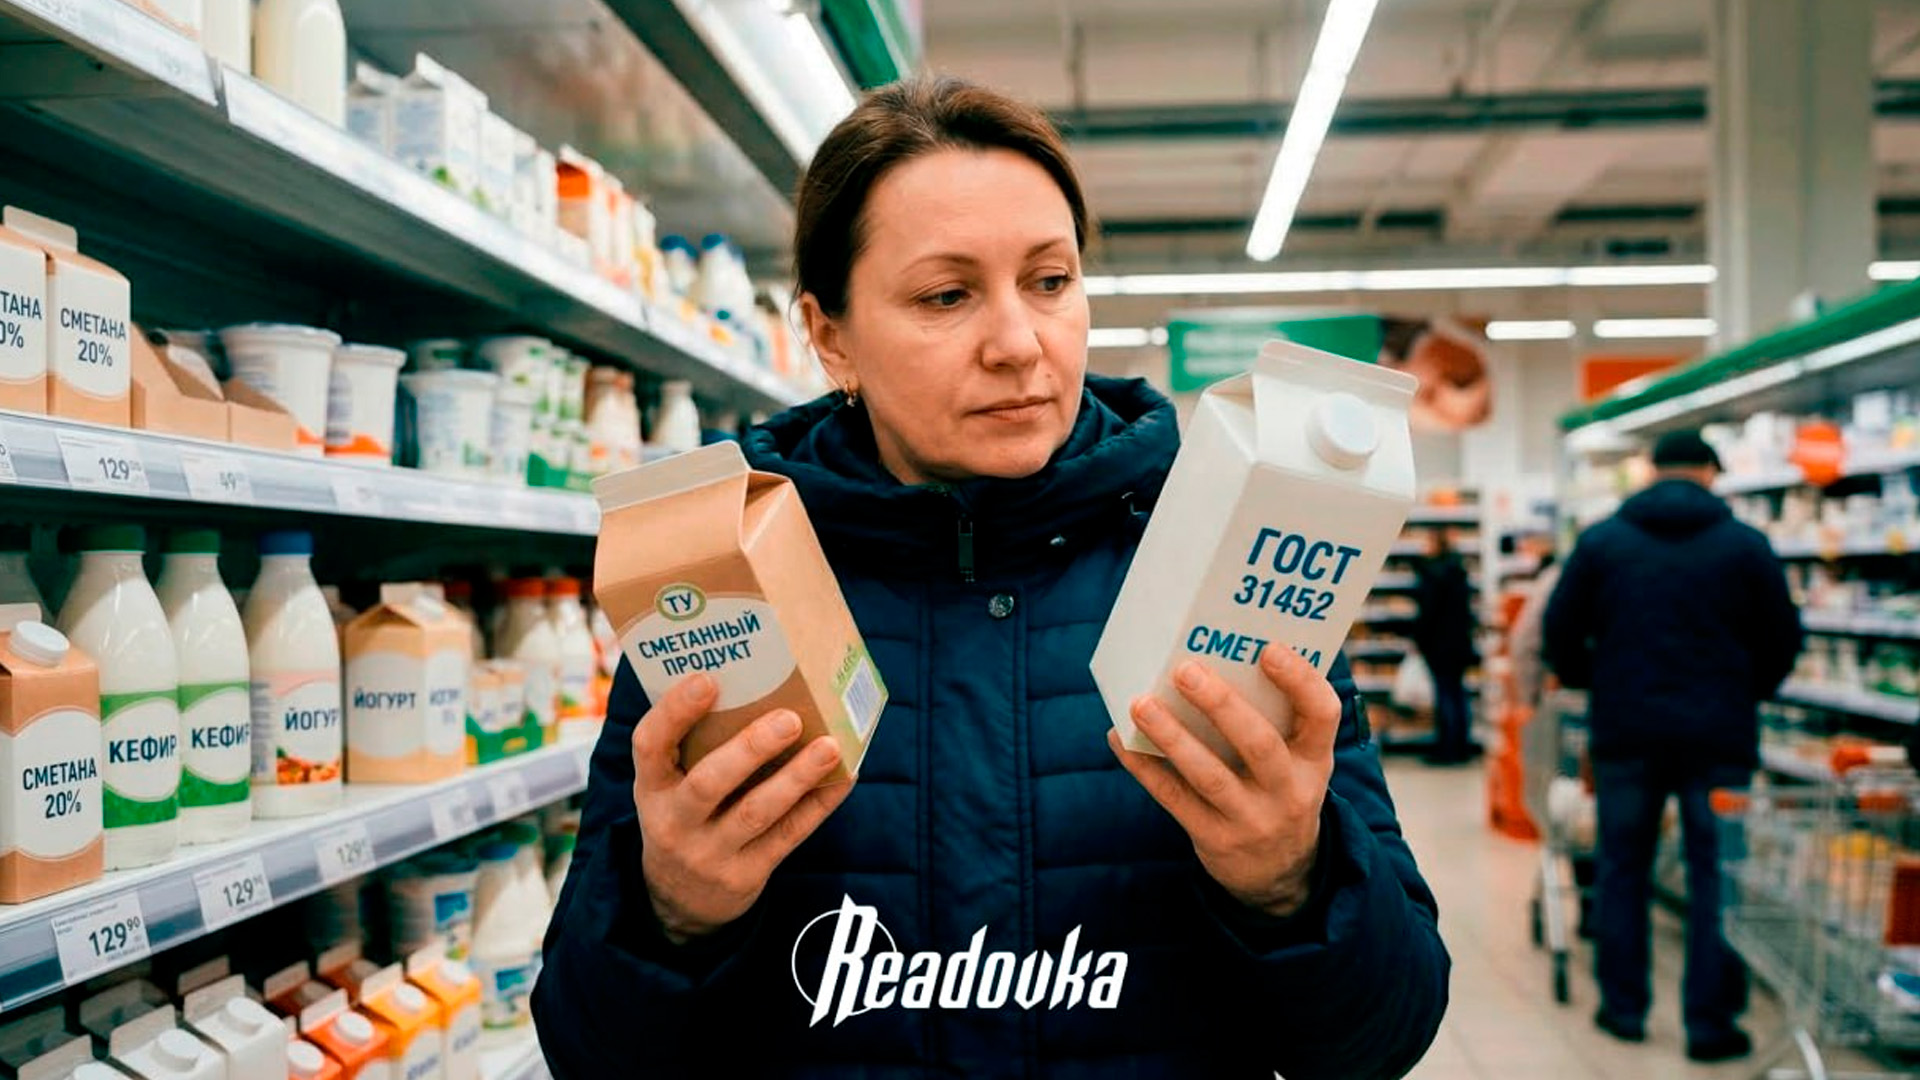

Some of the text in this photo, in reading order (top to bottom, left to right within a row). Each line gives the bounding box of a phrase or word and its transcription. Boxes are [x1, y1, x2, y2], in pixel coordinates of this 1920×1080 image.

[61, 307, 126, 340] СМЕТАНА
[78, 339, 113, 367] 20%
[1247, 527, 1362, 584] ГОСТ
[664, 592, 694, 613] ТУ
[1234, 575, 1335, 620] 31452
[638, 611, 762, 659] СМЕТАННЫЙ
[1186, 625, 1321, 668] СМЕТА
[662, 640, 753, 676] ПРОДУКТ
[353, 689, 416, 709] ЙОГУРТ
[109, 734, 177, 764] КЕФИР
[22, 757, 97, 791] СМЕТАНА
[44, 788, 82, 820] 20%
